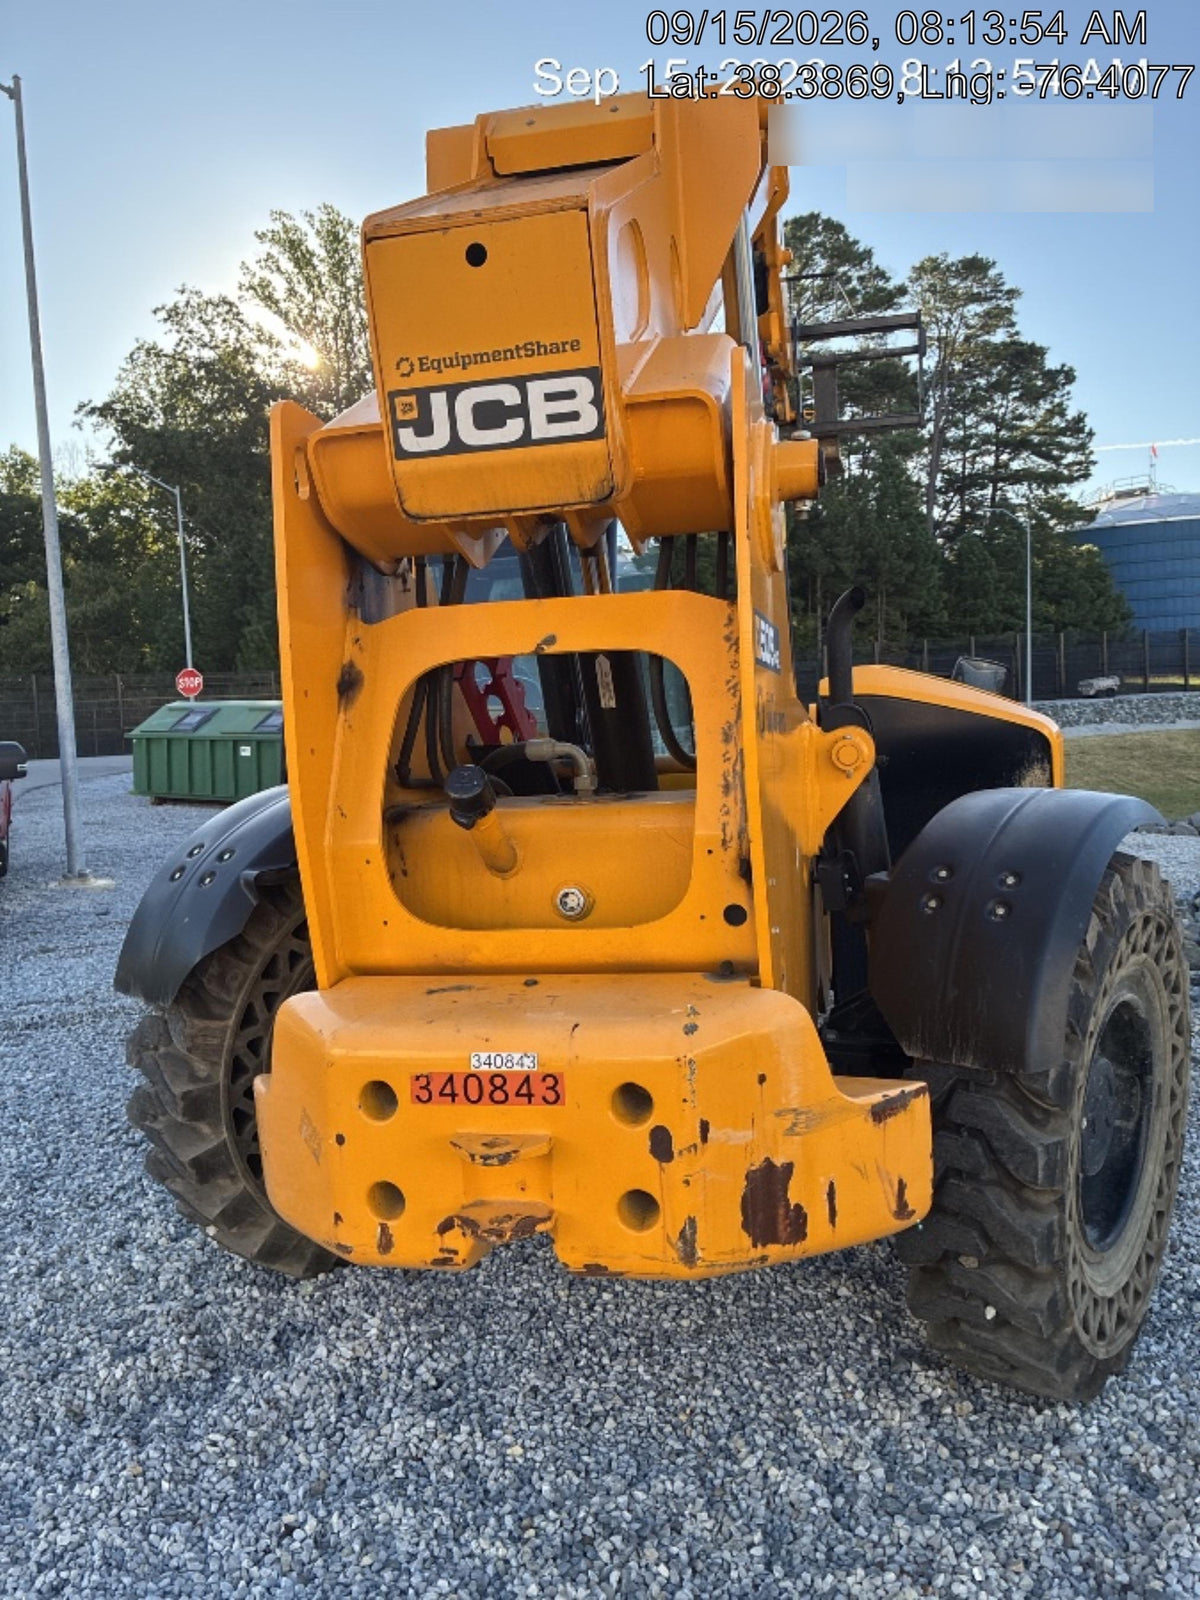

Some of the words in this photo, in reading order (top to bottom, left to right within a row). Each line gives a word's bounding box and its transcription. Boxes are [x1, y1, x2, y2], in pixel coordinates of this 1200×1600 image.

[418, 338, 581, 374] EquipmentShare
[398, 375, 599, 452] JCB
[179, 677, 201, 689] STOP
[472, 1053, 537, 1070] 340843
[415, 1073, 561, 1105] 340843
